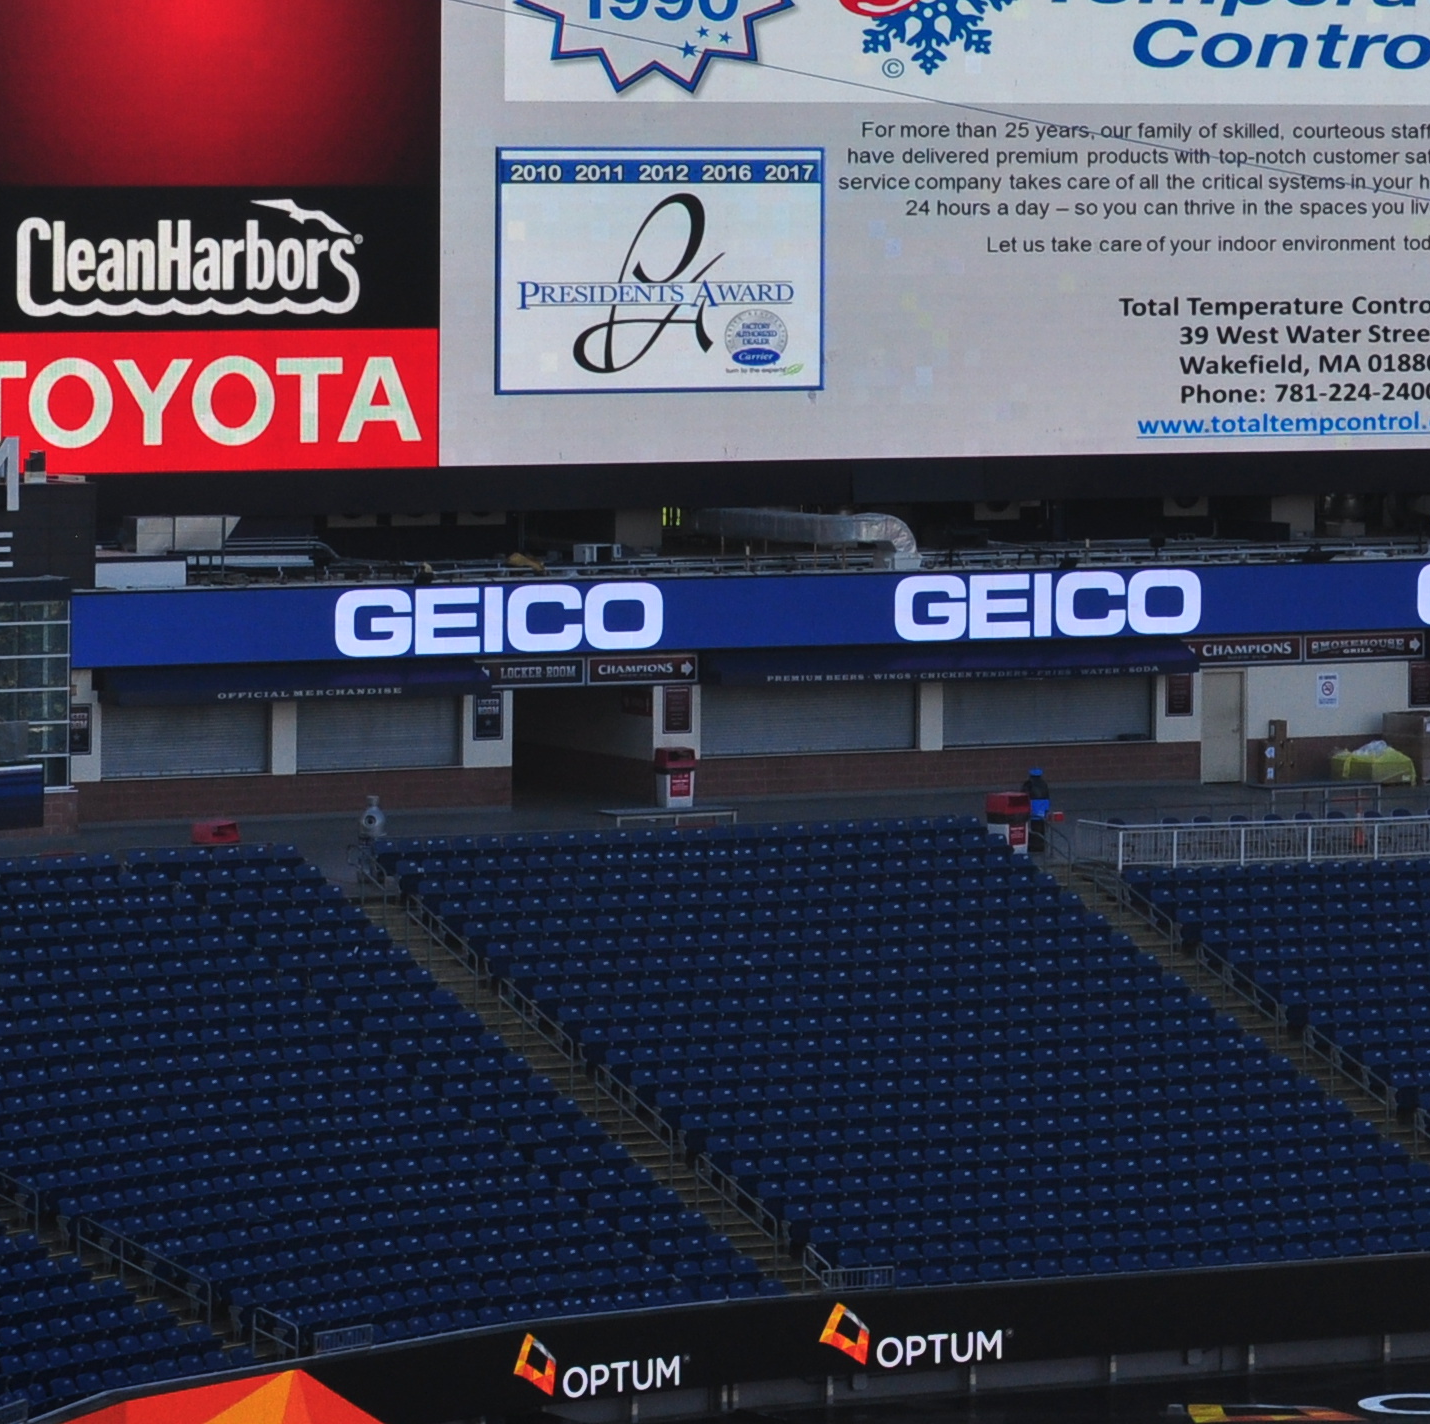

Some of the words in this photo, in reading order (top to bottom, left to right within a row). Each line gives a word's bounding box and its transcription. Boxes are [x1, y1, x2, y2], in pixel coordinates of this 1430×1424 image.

[861, 122, 895, 138] For
[900, 126, 950, 138] more
[956, 123, 996, 138] than
[1005, 122, 1029, 137] 25
[1036, 127, 1094, 142] years,
[1101, 126, 1131, 138] our
[1137, 123, 1191, 142] family
[1198, 123, 1218, 138] of
[1223, 123, 1285, 142] skilled,
[1293, 125, 1385, 139] courteous
[511, 165, 562, 181] 2010
[575, 165, 623, 181] 2011
[639, 165, 689, 181] 2012
[702, 165, 752, 181] 2016
[765, 165, 814, 181] 2017
[986, 237, 1016, 253] Let
[1023, 241, 1045, 253] us
[1051, 237, 1091, 253] take
[1099, 241, 1142, 253] care
[1146, 237, 1165, 253] of
[1170, 240, 1211, 256] your
[1218, 237, 1276, 252] indoor
[1282, 237, 1395, 252] environment
[17, 217, 361, 317] CleanHarbors
[516, 281, 684, 309] PRESIDENTS
[690, 280, 794, 308] AWARD
[1119, 297, 1179, 317] Total
[1187, 297, 1343, 321] Temperature
[1179, 326, 1208, 345] 39
[1217, 325, 1278, 345] West
[1287, 325, 1361, 345] Water
[1180, 354, 1310, 377] Wakefield,
[1319, 354, 1360, 373] MA
[1180, 384, 1266, 404] Phone:
[894, 569, 1201, 642] GEICO
[335, 582, 663, 657] GEICO
[1202, 642, 1292, 656] CHAMPIONS
[500, 667, 542, 679] LOCKER
[546, 666, 576, 677] ROOM
[598, 662, 673, 676] CHAMPIONS
[217, 691, 289, 700] OFFICIAL
[294, 687, 402, 697] MERCHANDISE
[876, 1330, 1002, 1369] OPTUM
[562, 1355, 680, 1399] OPTUM
